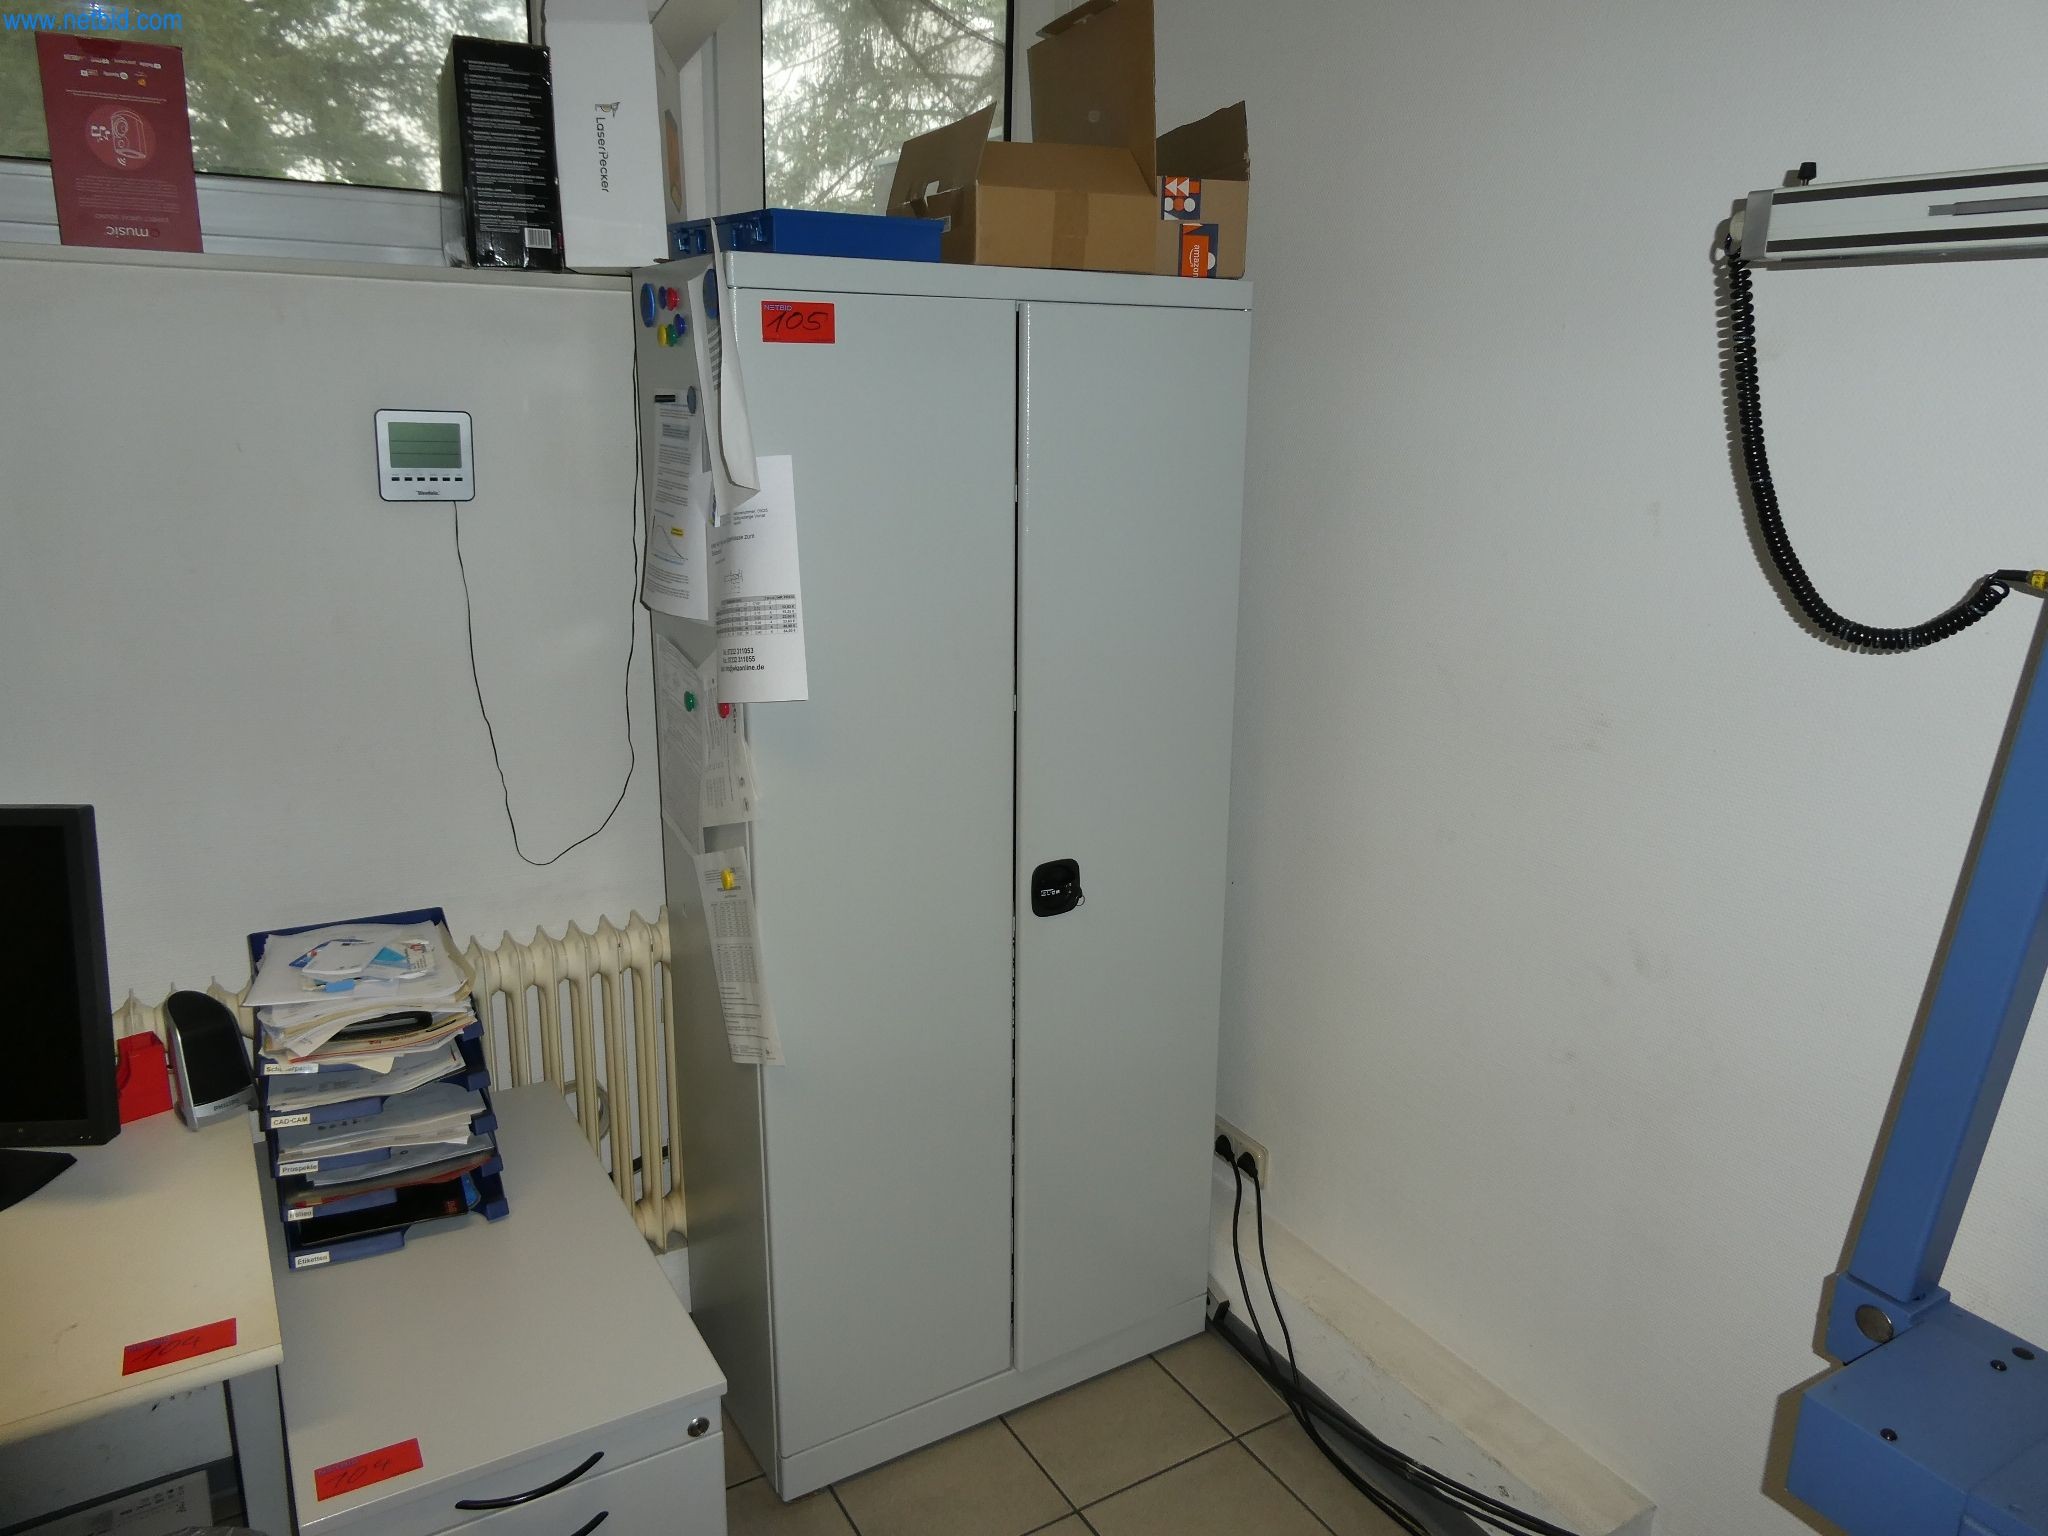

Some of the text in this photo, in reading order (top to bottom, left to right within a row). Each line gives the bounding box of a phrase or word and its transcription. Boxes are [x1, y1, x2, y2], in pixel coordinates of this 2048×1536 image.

[595, 117, 610, 193] LaserPecker
[106, 225, 150, 238] music
[1193, 244, 1201, 278] amazon
[763, 304, 793, 312] NETBID
[767, 311, 829, 333] 105
[273, 1116, 308, 1126] CAD-CAM
[297, 1255, 328, 1266] Etiketten
